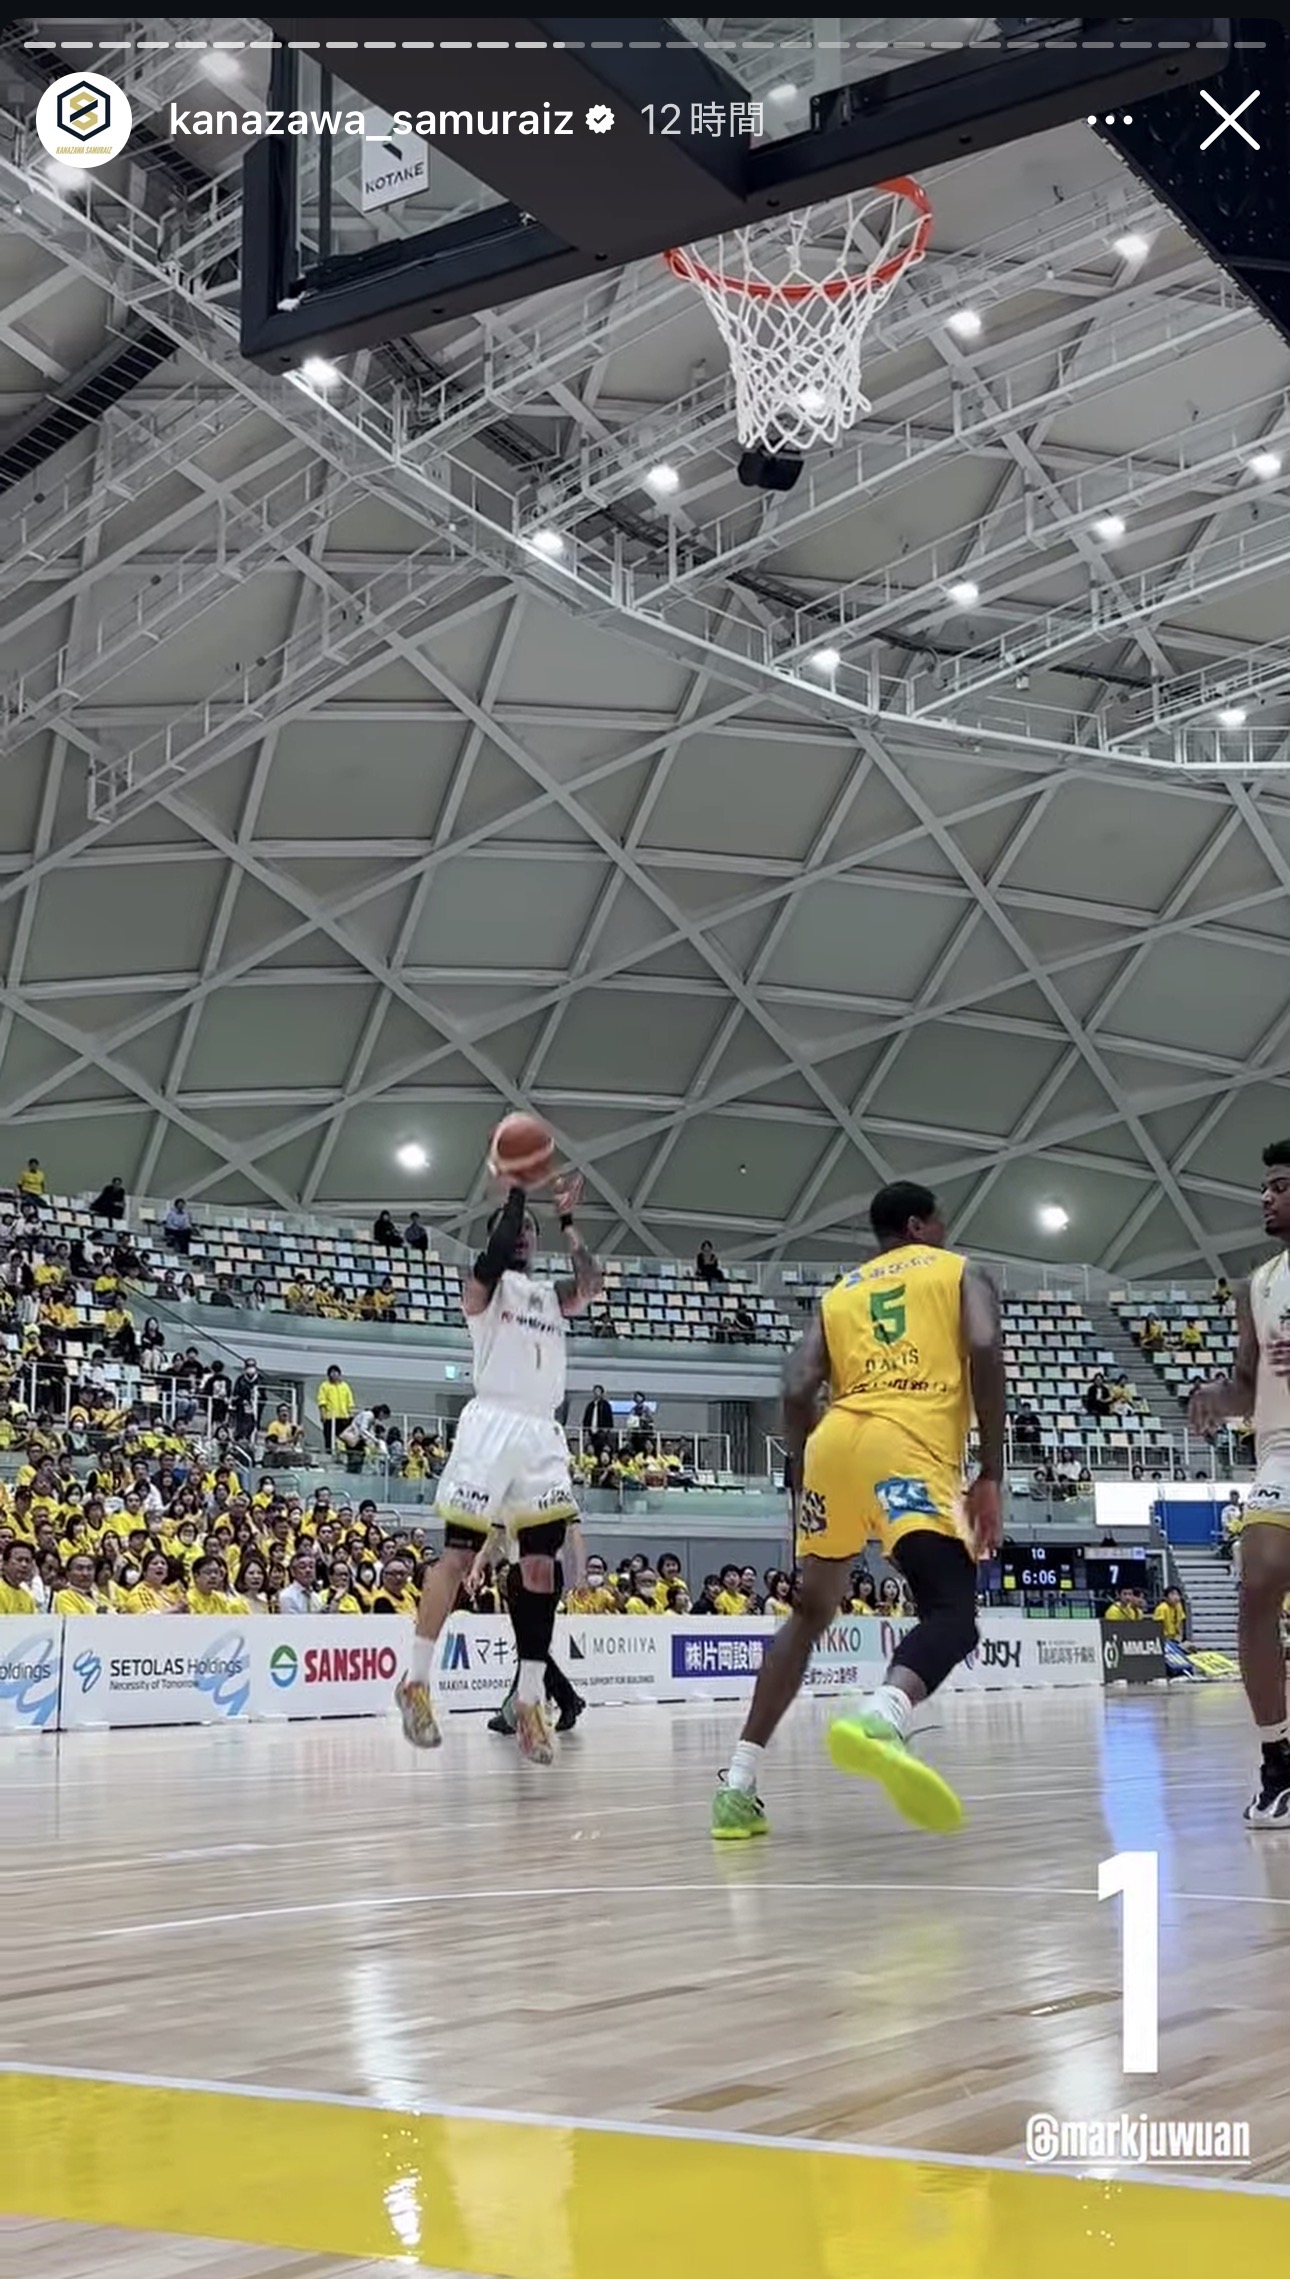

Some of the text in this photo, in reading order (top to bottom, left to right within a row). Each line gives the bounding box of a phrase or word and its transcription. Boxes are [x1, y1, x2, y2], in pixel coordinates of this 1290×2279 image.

[365, 161, 424, 195] KOTAKE
[870, 1283, 906, 1345] 5
[1031, 1547, 1046, 1560] 1Q
[1022, 1569, 1057, 1585] 6:06
[1109, 1564, 1119, 1585] 7
[593, 1636, 657, 1655] MORIIYA
[109, 1657, 243, 1678] SETOLAS Holdings
[303, 1646, 397, 1683] SANSHO
[109, 1680, 150, 1691] Necessity
[151, 1679, 160, 1690] of
